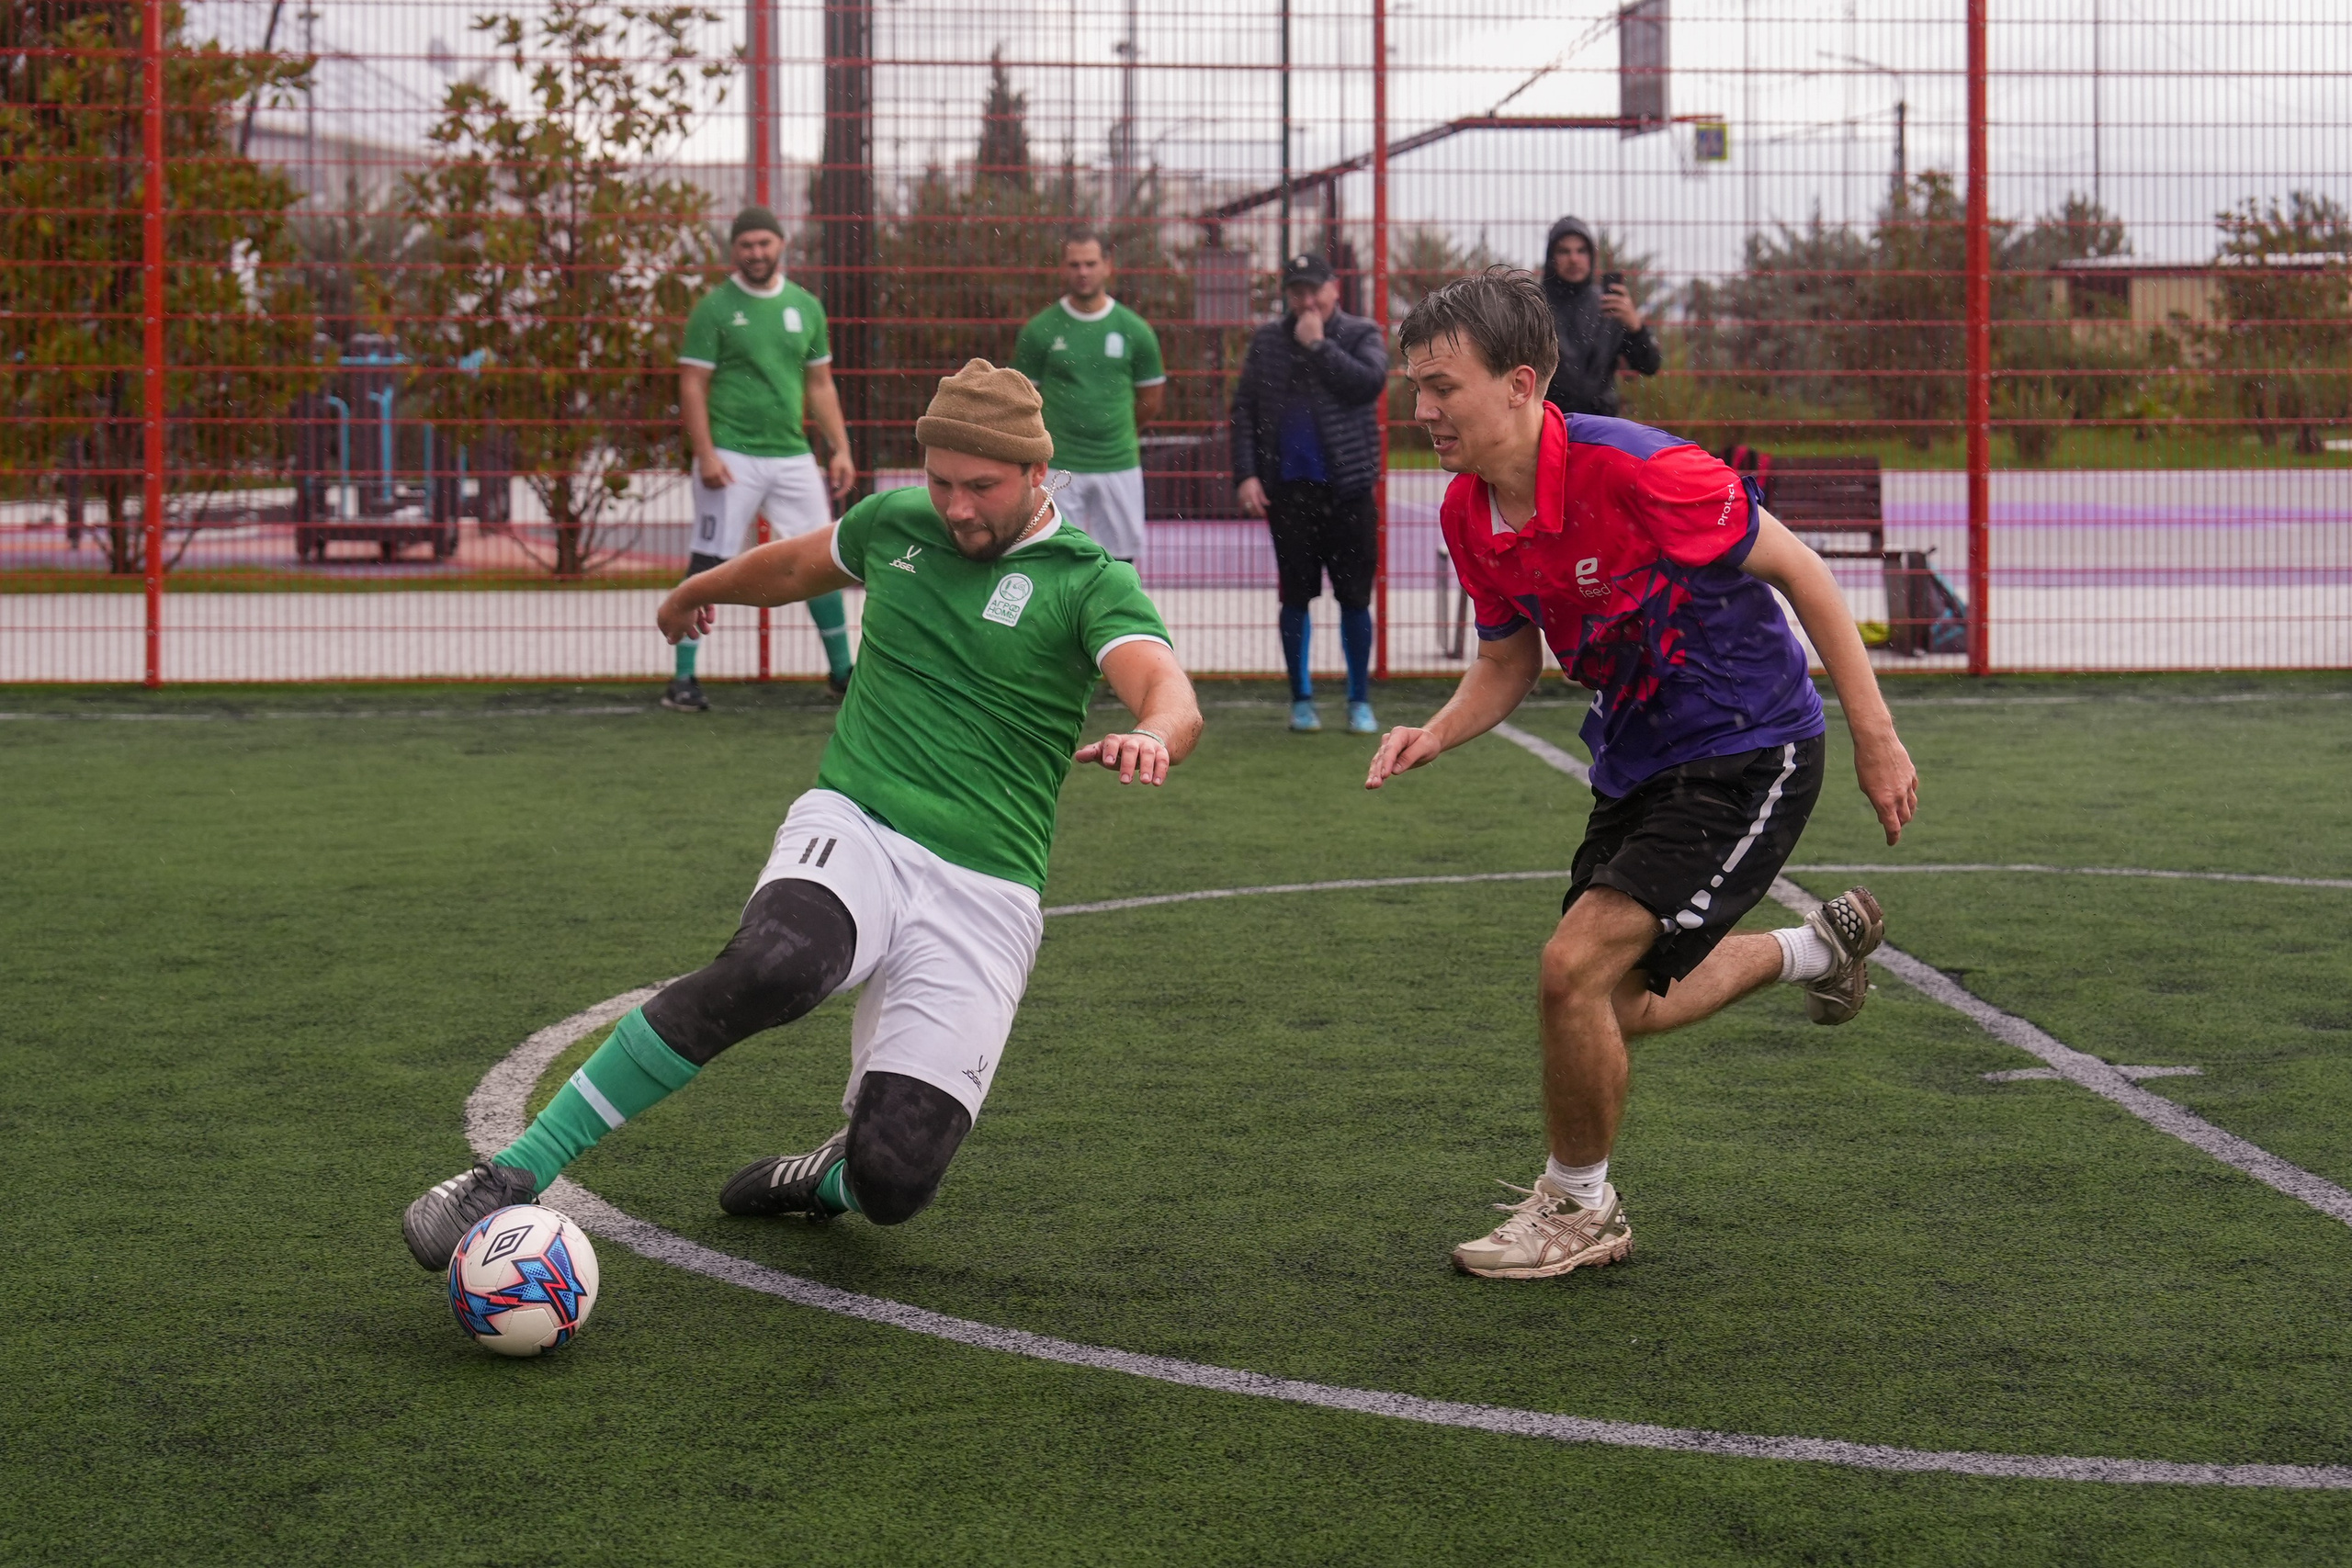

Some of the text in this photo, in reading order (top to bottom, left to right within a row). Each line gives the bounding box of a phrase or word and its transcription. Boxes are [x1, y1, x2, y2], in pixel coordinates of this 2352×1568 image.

[1578, 582, 1611, 598] feed
[987, 605, 1018, 620] НОМЫ
[798, 837, 837, 869] 11
